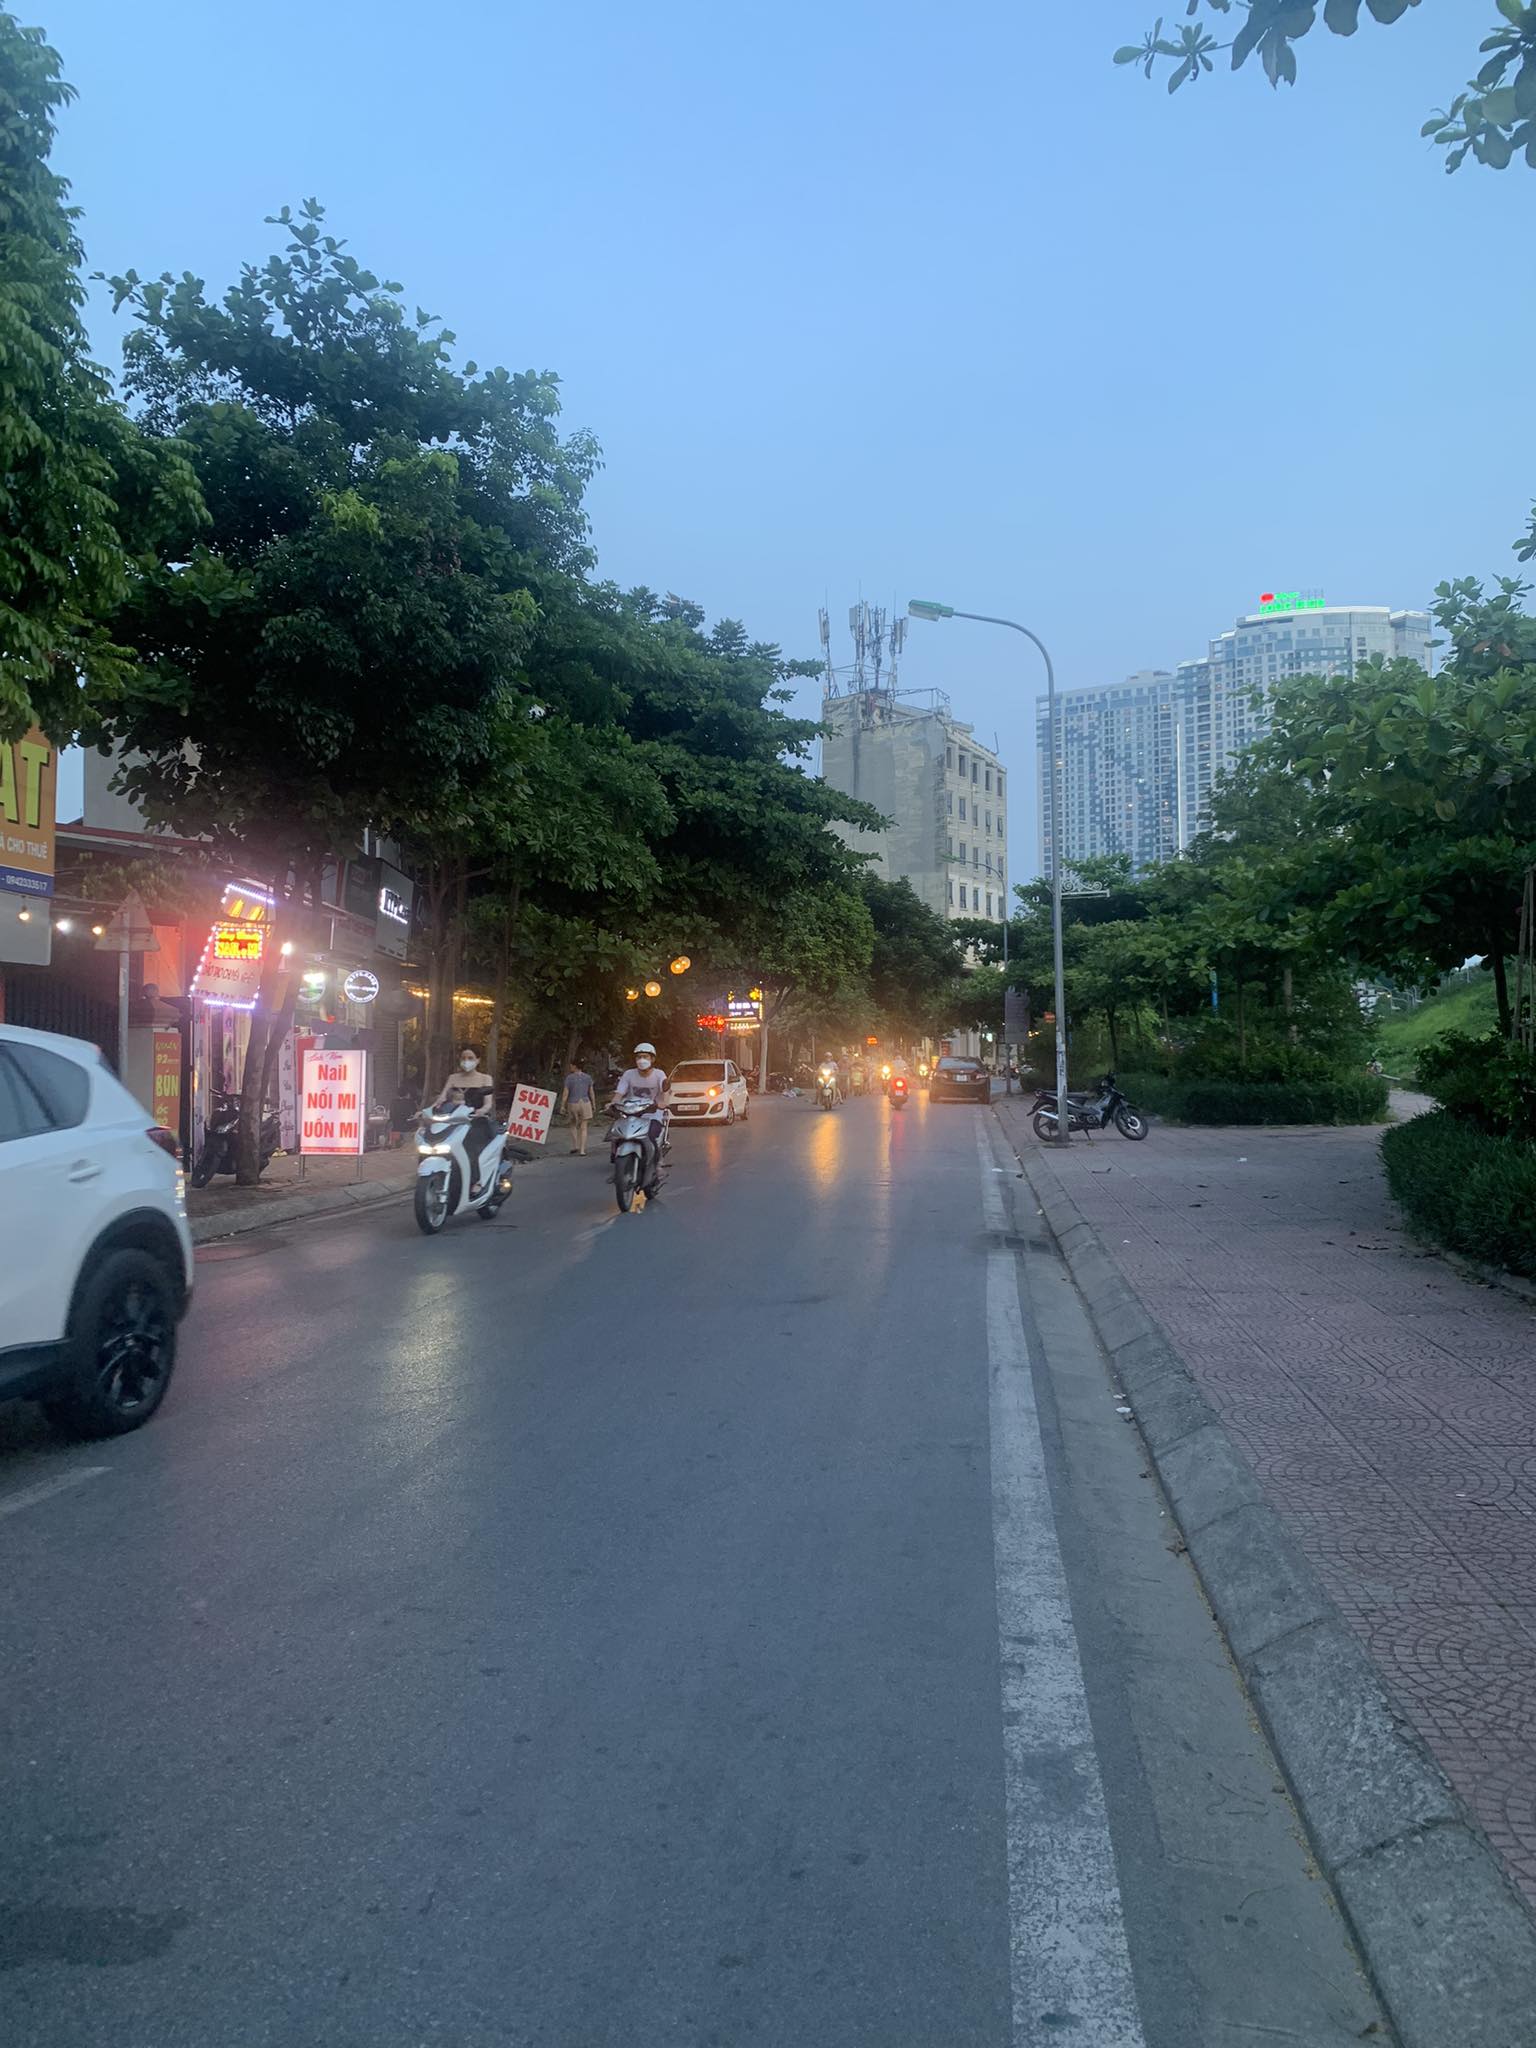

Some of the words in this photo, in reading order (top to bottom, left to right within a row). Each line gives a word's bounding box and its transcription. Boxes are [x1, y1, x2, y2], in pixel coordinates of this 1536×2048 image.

[7, 837, 25, 854] CHO
[26, 840, 48, 860] THUÊ
[156, 1069, 179, 1097] BÚN
[318, 1064, 347, 1081] Nail
[308, 1088, 332, 1109] NỐI
[338, 1093, 356, 1110] MI
[519, 1107, 540, 1123] XE
[304, 1116, 334, 1138] UỐN
[339, 1122, 358, 1139] MI
